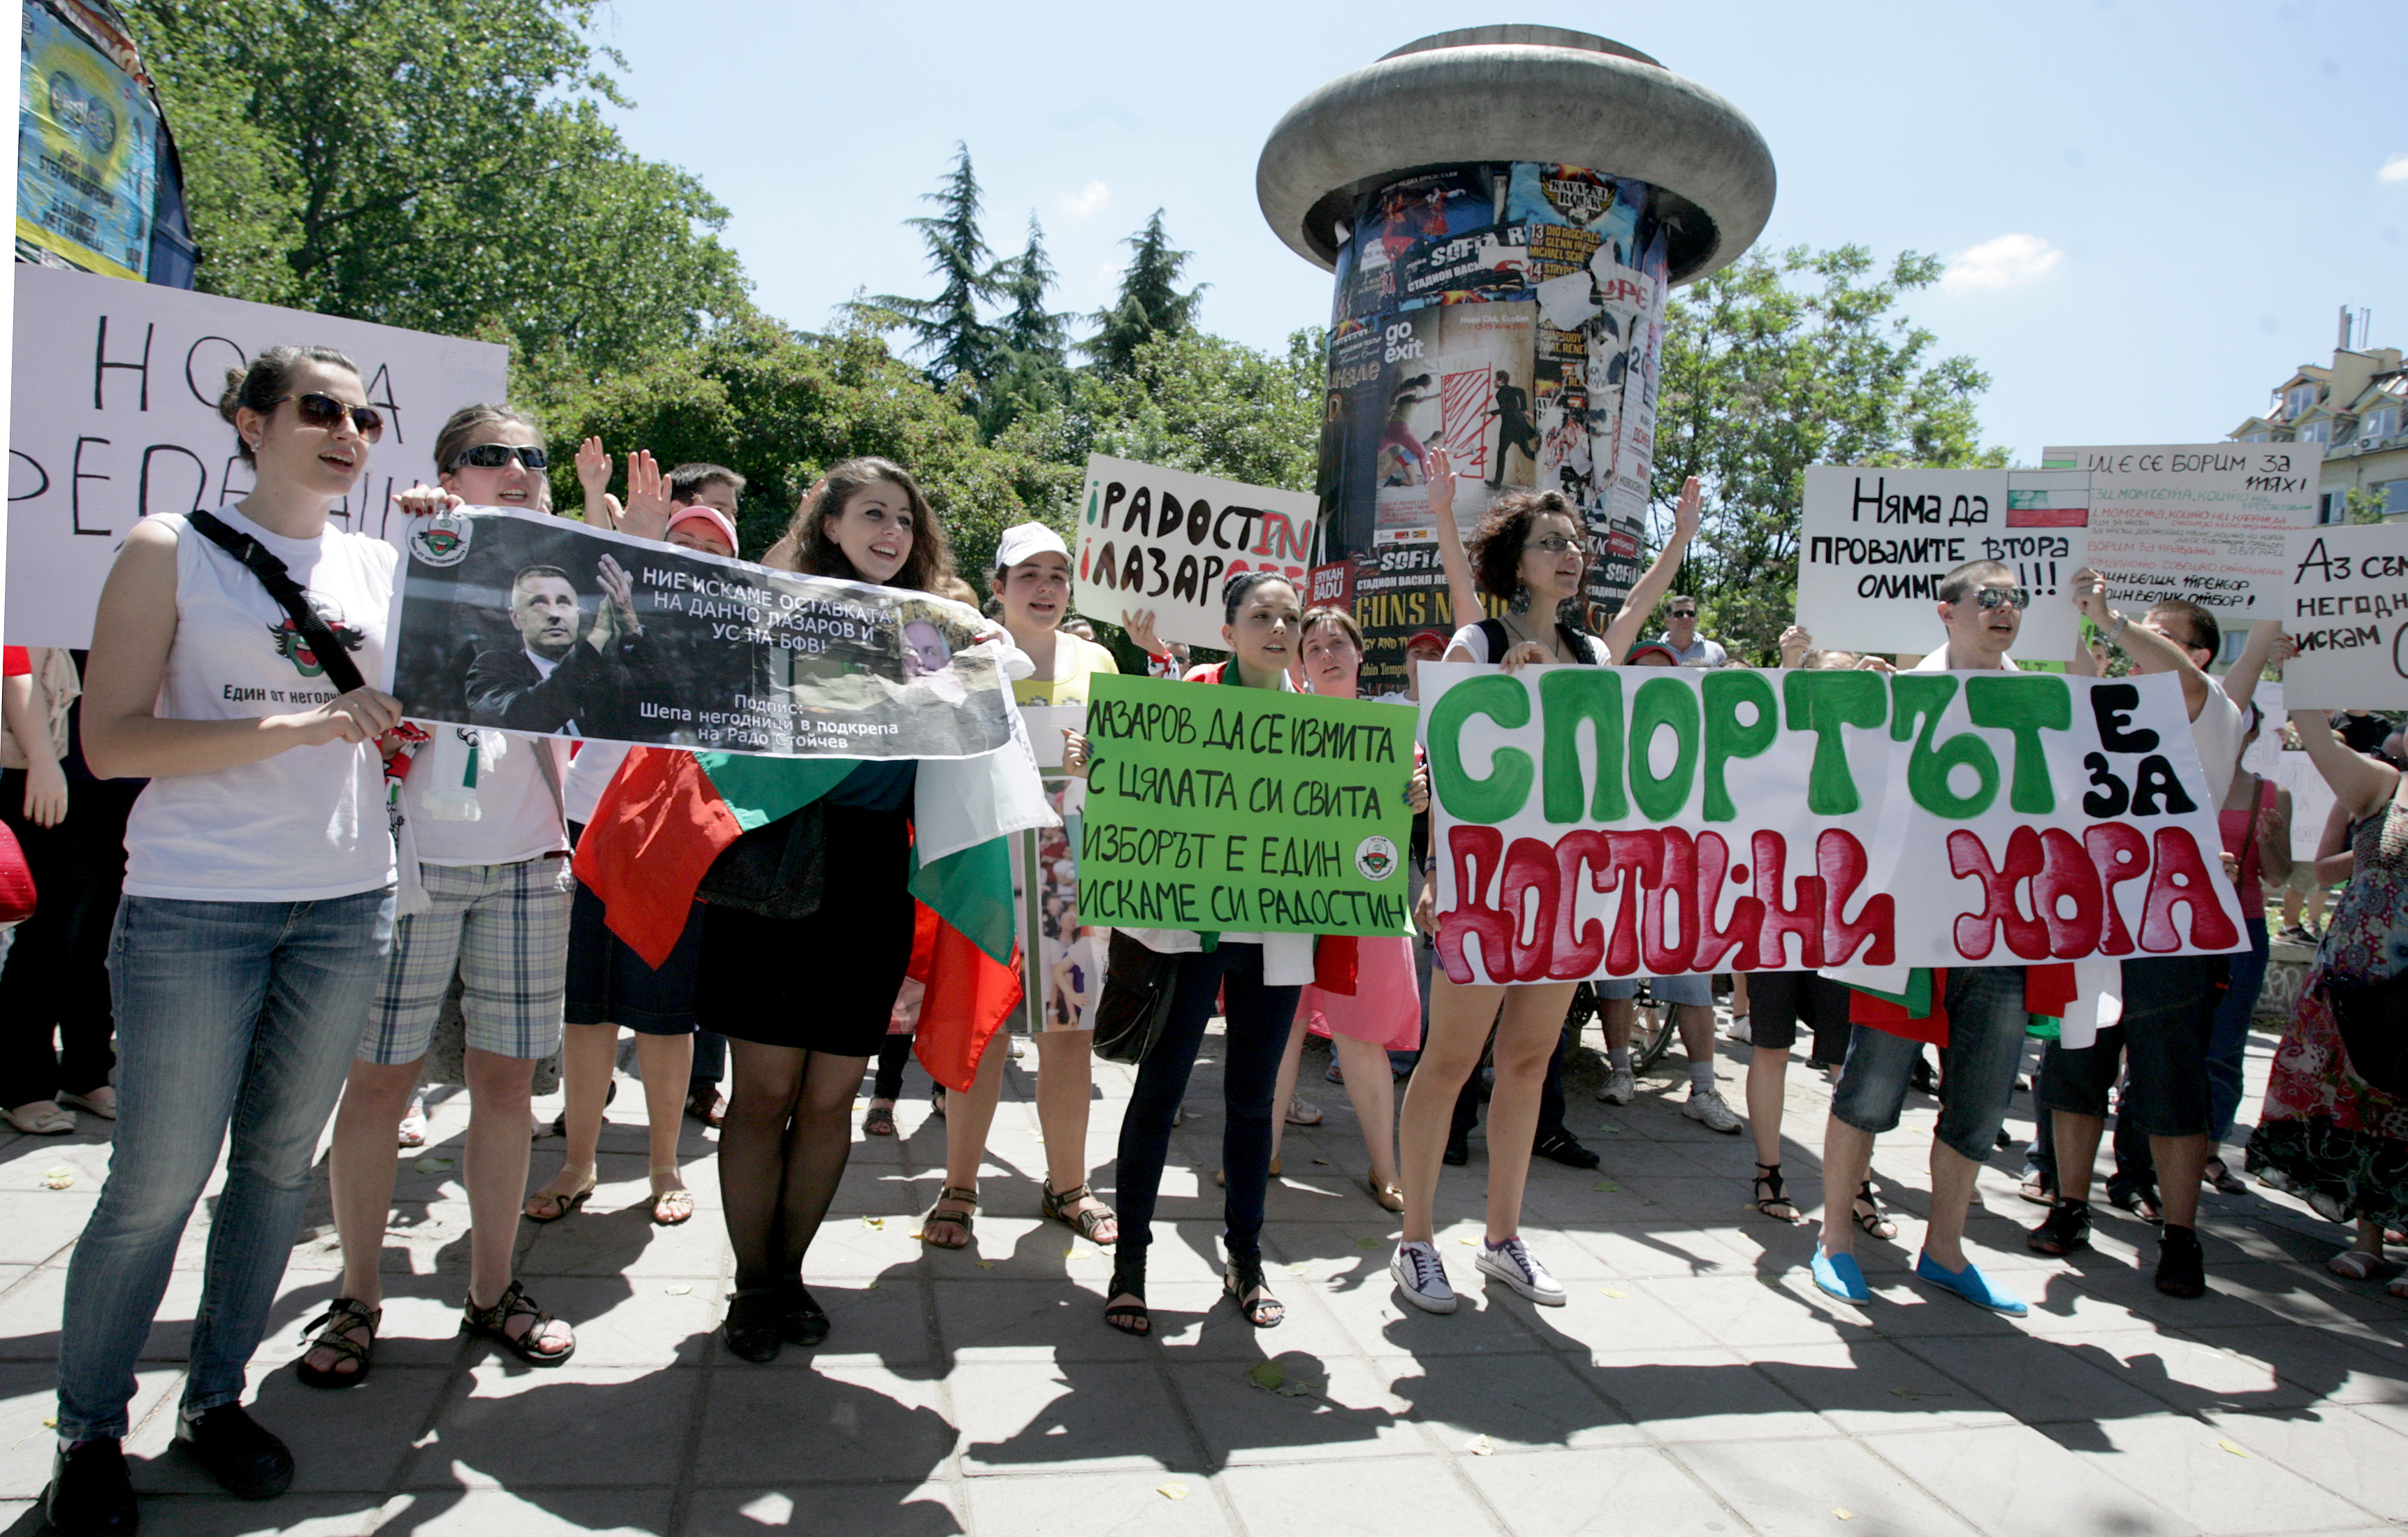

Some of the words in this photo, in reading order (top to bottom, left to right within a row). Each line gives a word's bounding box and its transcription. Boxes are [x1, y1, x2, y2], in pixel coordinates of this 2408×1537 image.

[1531, 224, 1544, 238] 13
[1546, 225, 1561, 238] DIO
[1545, 237, 1574, 249] GLENN
[1529, 245, 1564, 259] MICHAEL
[1407, 270, 1453, 292] СТАДИОН
[1529, 262, 1542, 277] 14
[1386, 321, 1413, 347] go
[1385, 338, 1424, 364] exit
[95, 315, 404, 444] НОА
[2139, 455, 2165, 472] СЕ
[2172, 454, 2247, 473] БОРИМ
[1853, 477, 1942, 523] Няма
[1949, 495, 1989, 527] да
[2087, 541, 2136, 551] БОРИМ
[2138, 543, 2154, 552] ЗА
[1315, 567, 1344, 585] ERYKAH
[1357, 577, 1397, 591] СТАДИОН
[1398, 574, 1432, 587] ВАСИЛ
[1433, 574, 1448, 585] ЛЕ
[2129, 573, 2176, 585] ВЕЛИК
[643, 567, 687, 590] НИЕ
[693, 578, 773, 604] ИСКАМЕ
[779, 594, 893, 624] ОСТАВКАТА
[1313, 580, 1343, 602] BADU
[653, 591, 683, 611] НА
[688, 597, 761, 624] ДАНЧО
[766, 611, 856, 639] ЛАЗАРОВ
[861, 627, 875, 642] И
[1356, 594, 1426, 628] GUNS
[712, 622, 740, 641] УС
[747, 627, 774, 646] НА
[780, 634, 827, 655] БФВ!
[224, 685, 266, 701] Един
[270, 690, 285, 703] от
[734, 694, 804, 715] Подпис:
[640, 701, 692, 722] Шепа
[699, 712, 794, 732] негодници
[801, 720, 810, 730] в
[816, 720, 898, 737] подкрепа
[1087, 699, 1196, 743] ЛАЗАРОВ
[1203, 709, 1244, 750] ДА
[1250, 714, 1285, 754] СЕ
[1291, 717, 1395, 763] ИЗМИТА
[2091, 683, 2161, 753] Е
[699, 728, 724, 741] на
[727, 727, 768, 747] Радо
[775, 729, 848, 750] Стойчев
[1428, 669, 2072, 824] СПОРТЪТ
[1087, 759, 1105, 794] С
[1119, 762, 1237, 810] ЦЯЛАТА
[1249, 778, 1284, 814] СИ
[1294, 780, 1382, 820] СВИТА
[2083, 752, 2198, 819] ЗА
[1082, 822, 1215, 868] ИЗБОРЪТ
[1226, 836, 1247, 871] Е
[1261, 837, 1342, 877] ЕДИН
[1078, 879, 1199, 922] ИСКАМЕ
[1211, 887, 1249, 922] СИ
[1258, 888, 1406, 928] РАДОСТИН
[1947, 822, 2240, 961] ХОРА
